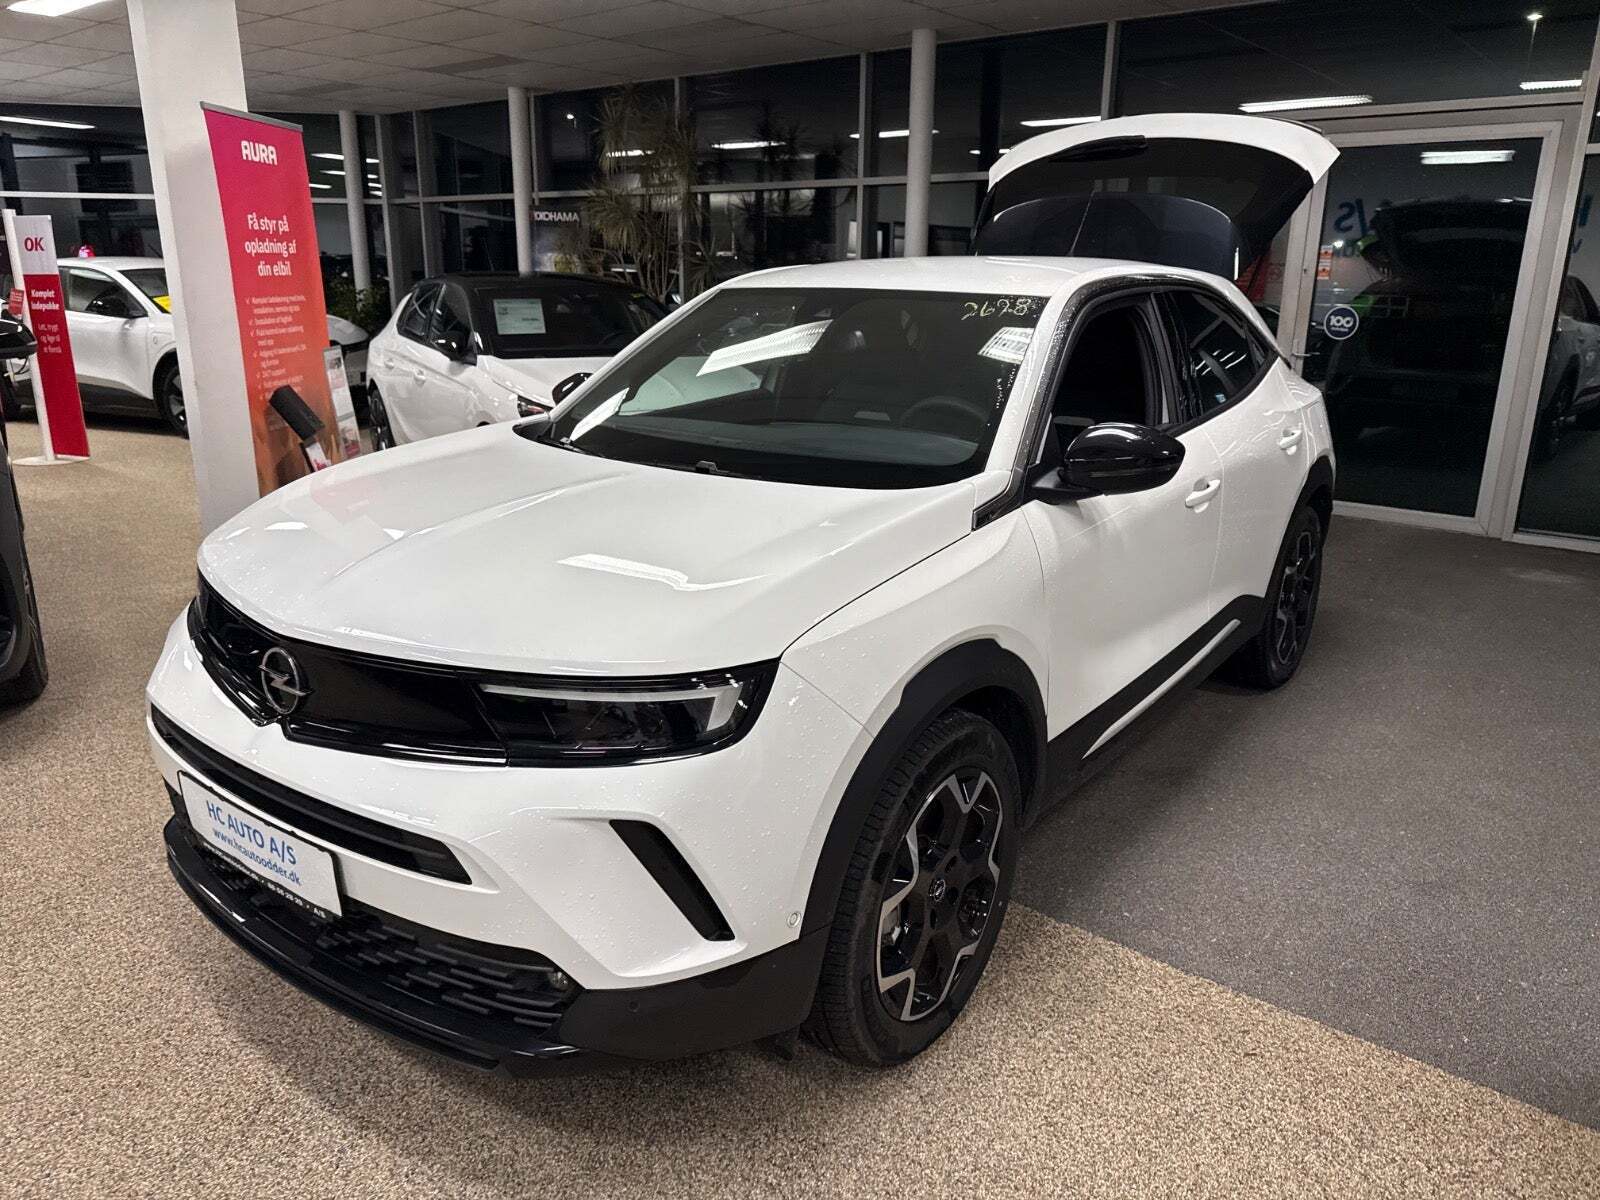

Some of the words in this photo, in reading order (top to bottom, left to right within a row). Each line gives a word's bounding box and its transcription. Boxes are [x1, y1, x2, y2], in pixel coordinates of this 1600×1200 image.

[241, 140, 278, 166] AURA
[247, 212, 259, 231] Få
[260, 217, 276, 234] styr
[278, 214, 289, 235] på
[24, 236, 45, 252] OK
[245, 238, 288, 257] opladning
[288, 240, 297, 254] af
[257, 261, 272, 277] din
[273, 261, 292, 277] elbil
[31, 289, 55, 299] Komplet
[1329, 315, 1354, 328] 100
[207, 800, 226, 826] HC
[228, 813, 265, 850] AUTO
[270, 836, 297, 865] A/S
